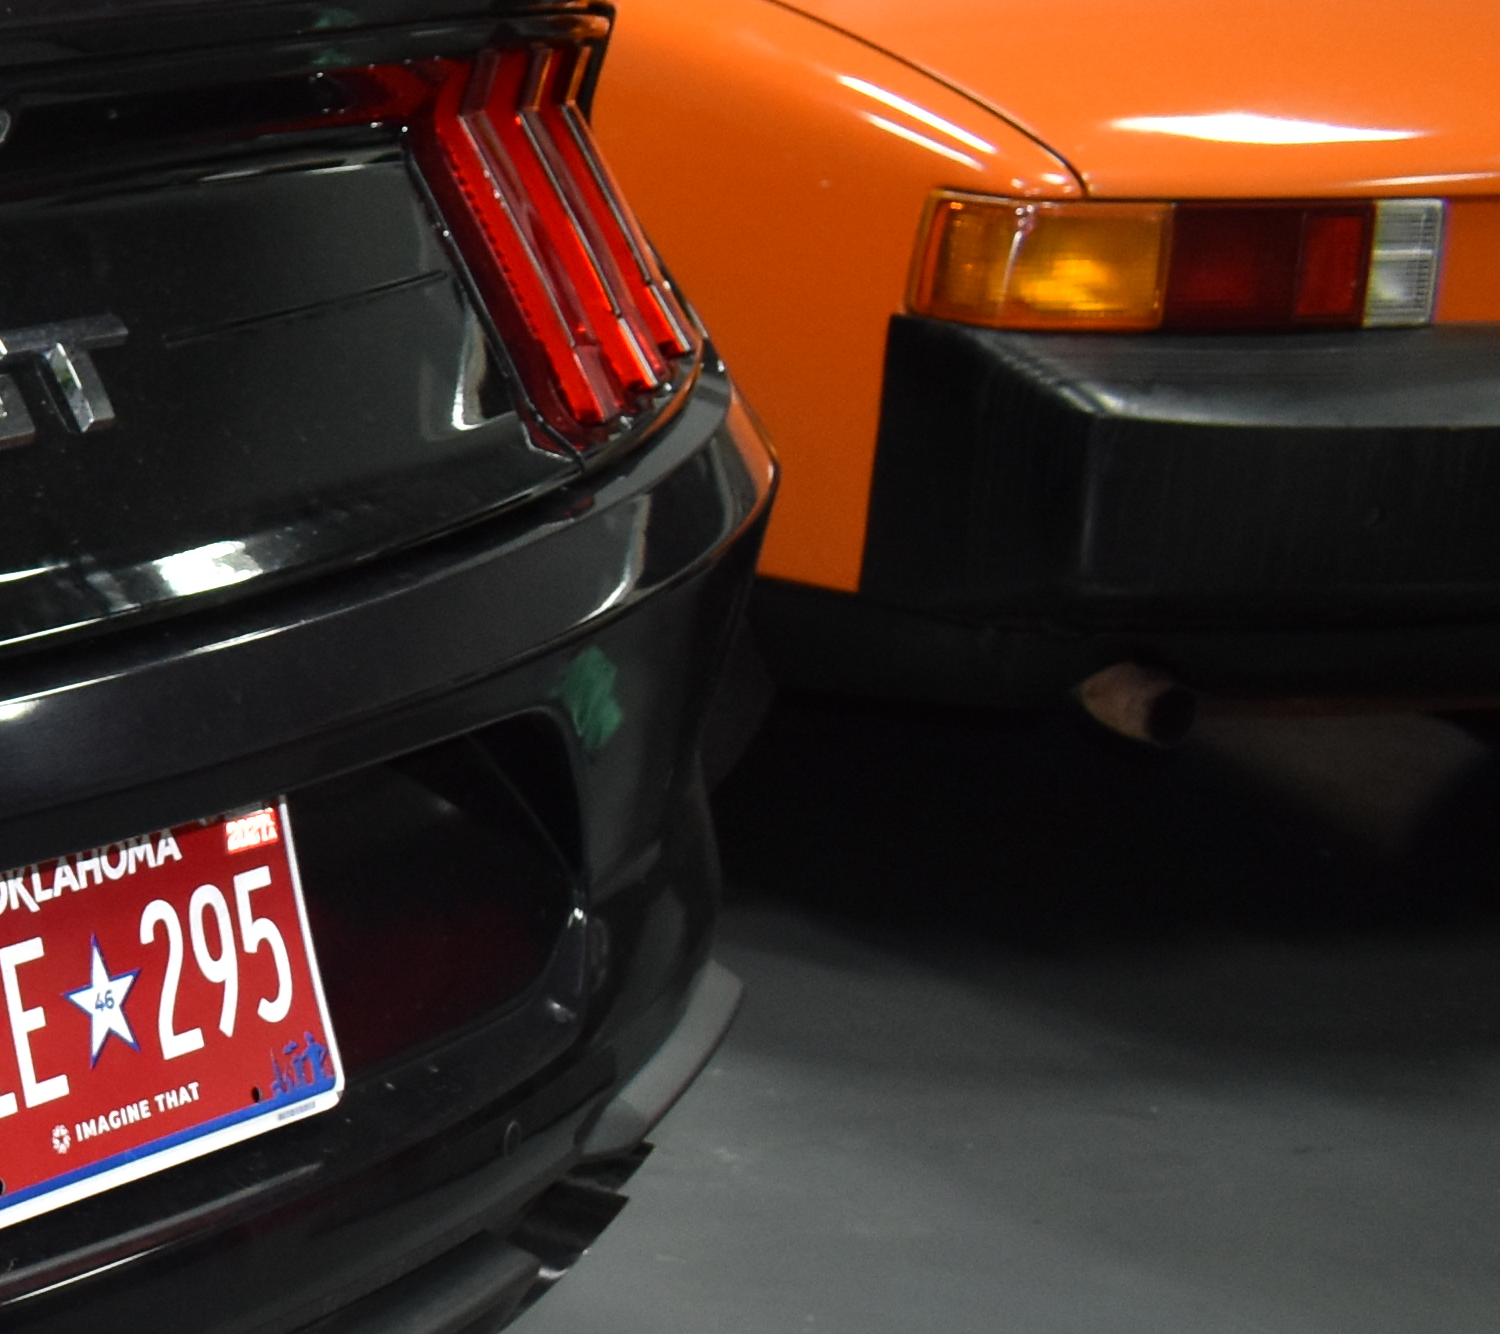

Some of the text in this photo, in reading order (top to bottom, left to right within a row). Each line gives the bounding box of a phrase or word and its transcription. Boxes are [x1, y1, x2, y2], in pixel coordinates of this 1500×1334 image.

[139, 865, 294, 1061] 295
[95, 988, 115, 1012] 46
[74, 1082, 200, 1142] IMAGINE THAT
